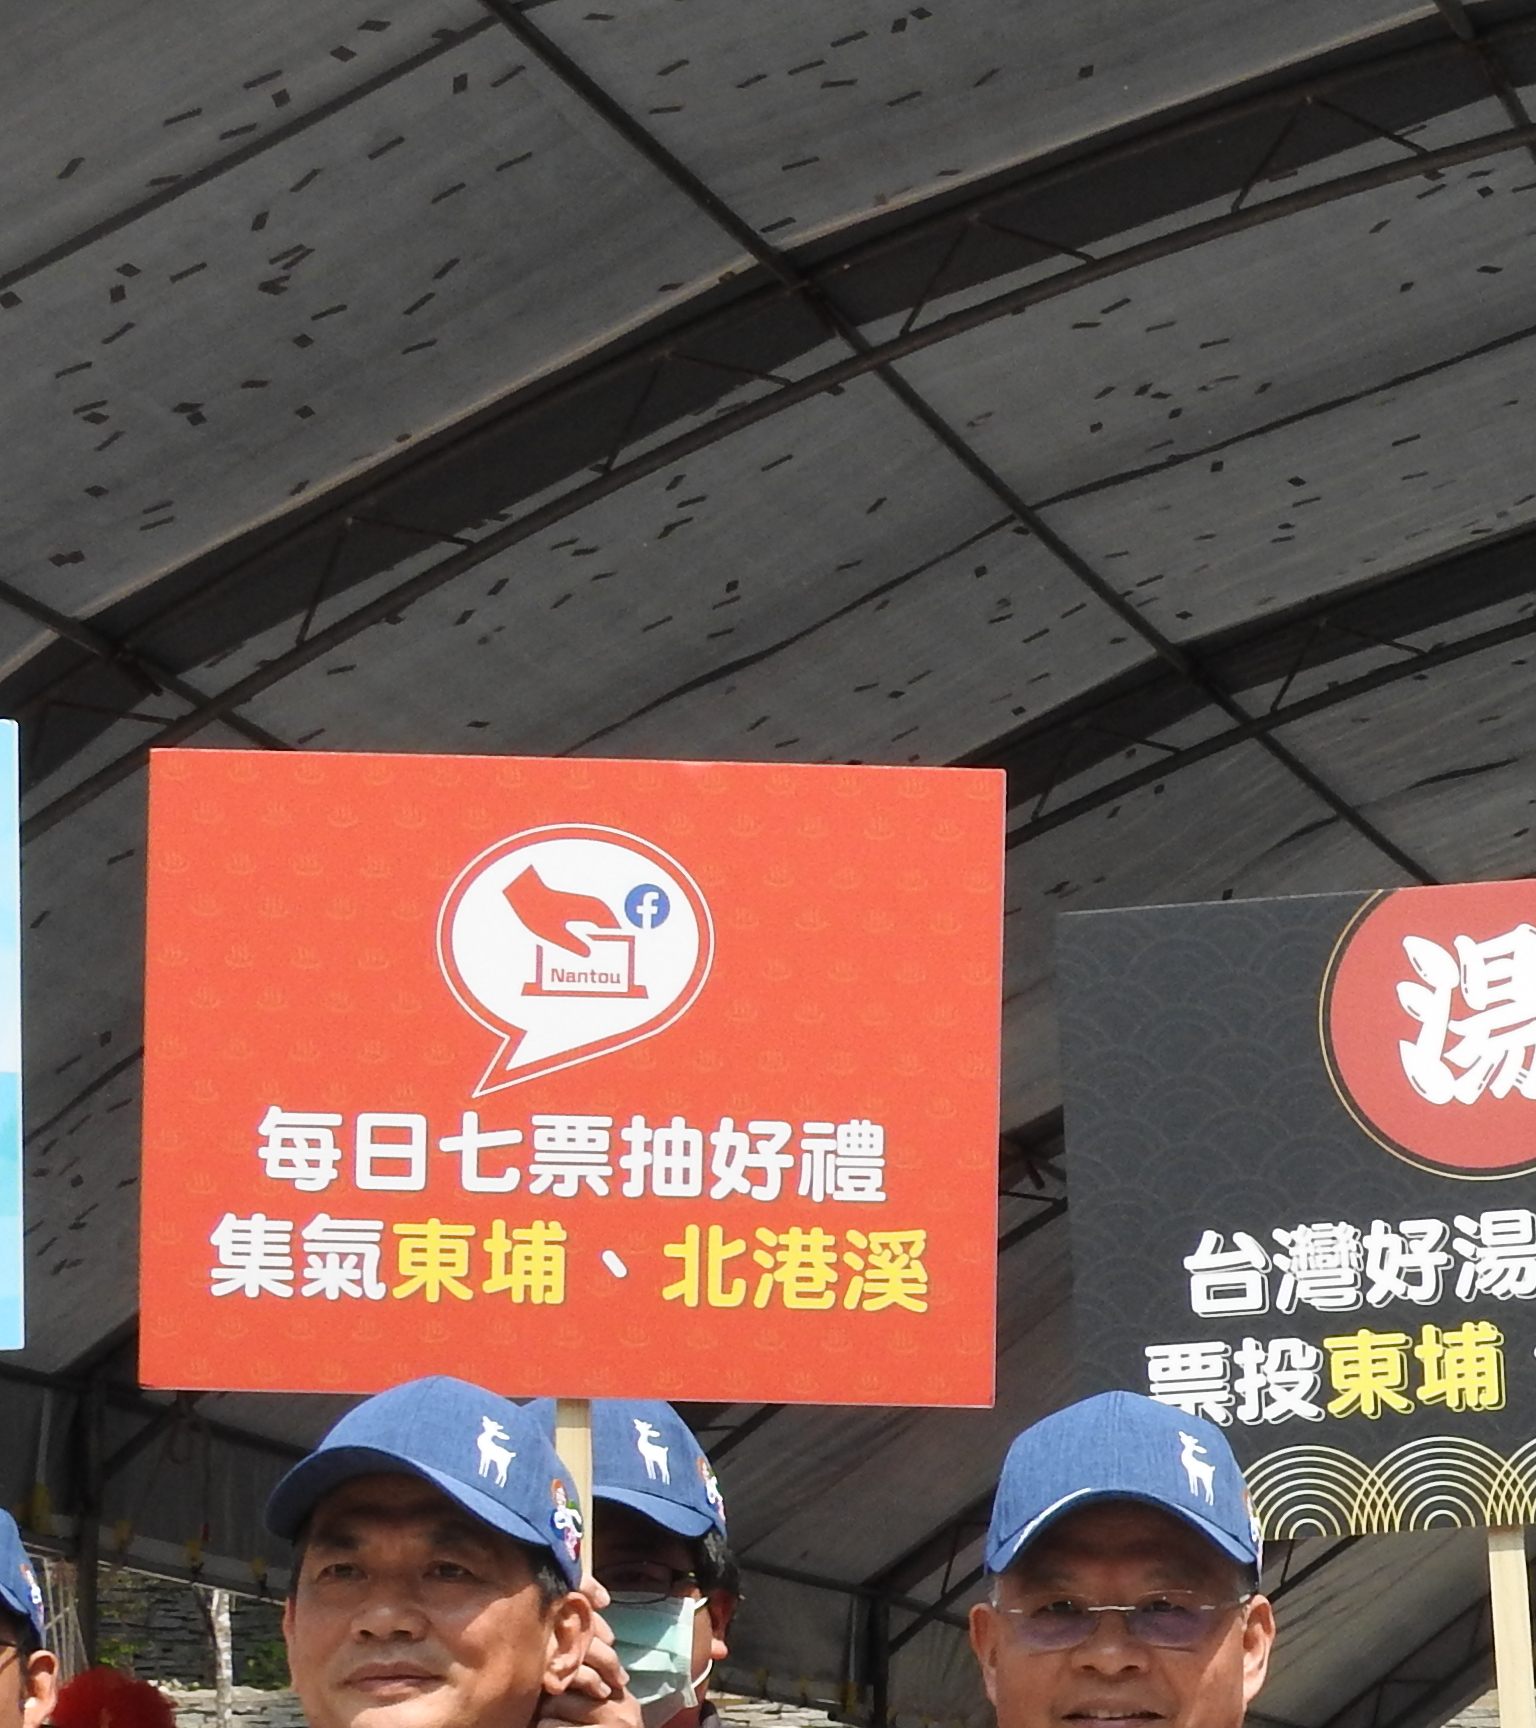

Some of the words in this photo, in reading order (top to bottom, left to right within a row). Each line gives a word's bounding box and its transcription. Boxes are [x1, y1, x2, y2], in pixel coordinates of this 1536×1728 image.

[551, 967, 621, 984] Nantou
[257, 1105, 887, 1204] 每日七票抽好禮
